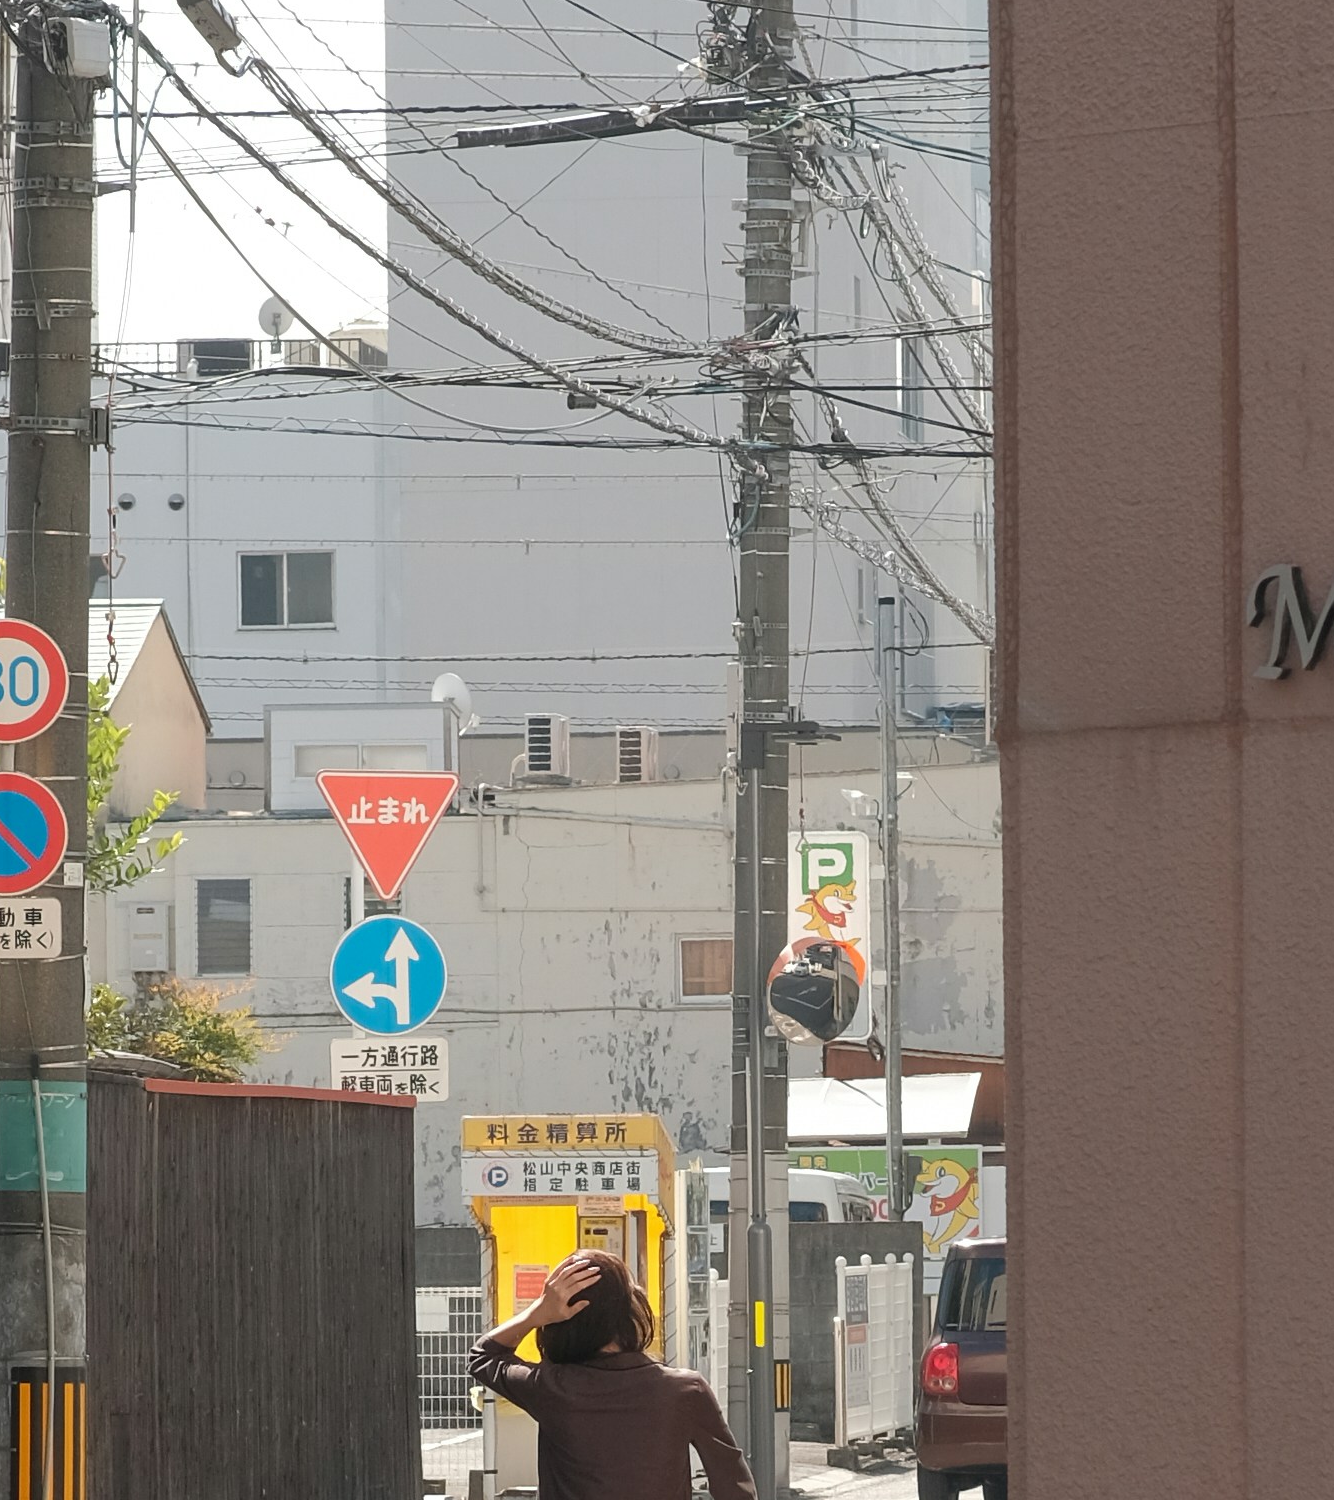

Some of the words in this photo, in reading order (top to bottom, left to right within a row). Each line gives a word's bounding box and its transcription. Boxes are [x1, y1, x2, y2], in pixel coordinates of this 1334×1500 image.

[347, 796, 430, 824] 止まれ
[808, 848, 847, 890] P
[341, 1045, 438, 1067] 一方通行路
[341, 1074, 440, 1095] 軽車両を除く
[487, 1122, 627, 1145] 料金精算所
[523, 1161, 641, 1176] 松山中央商店街
[523, 1177, 641, 1192] 指定駐車場
